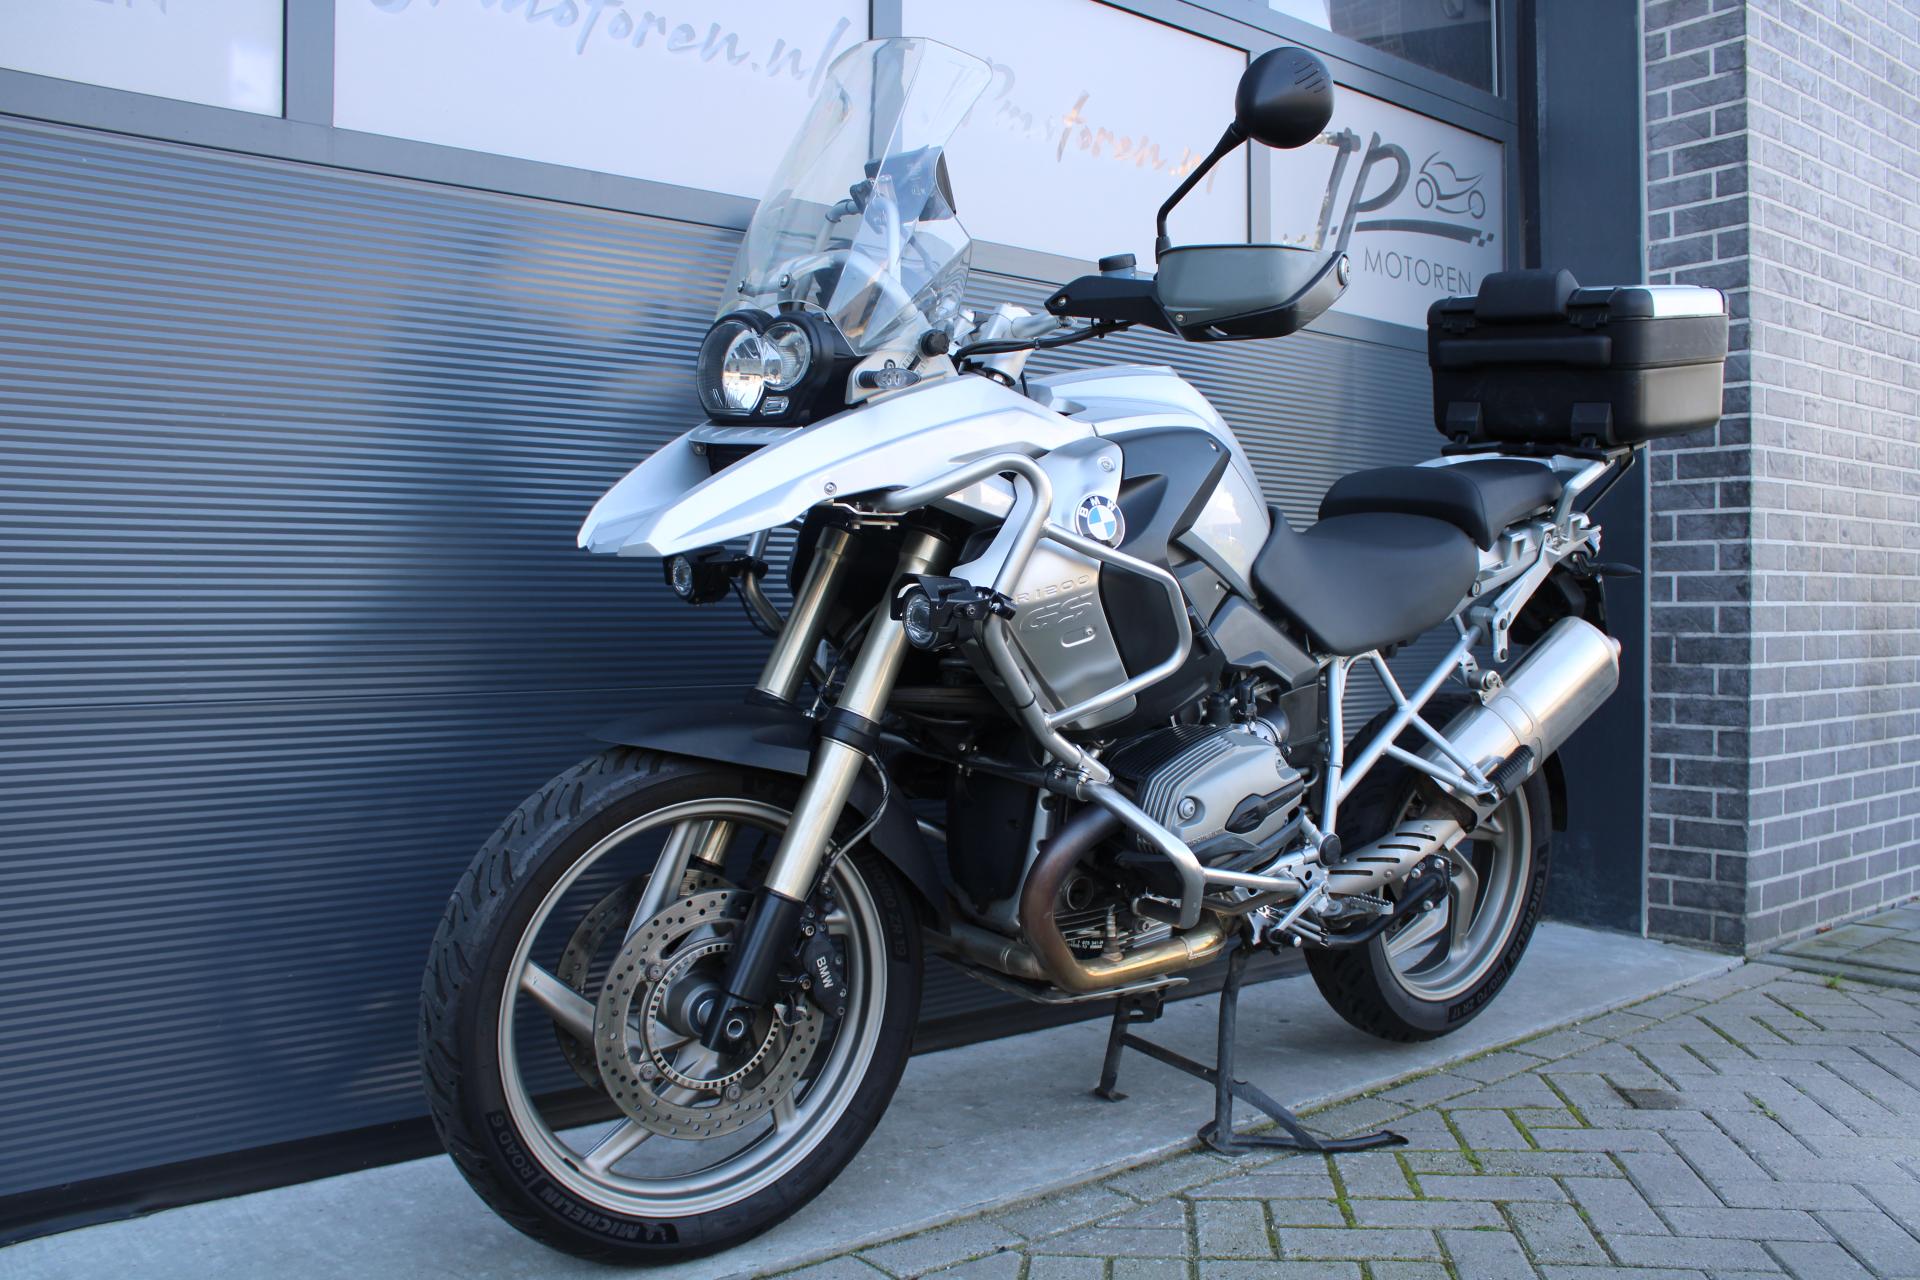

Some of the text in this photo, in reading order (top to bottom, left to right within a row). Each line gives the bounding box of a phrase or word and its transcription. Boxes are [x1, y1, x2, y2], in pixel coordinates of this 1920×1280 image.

[1364, 248, 1471, 294] MOTOREN
[1079, 496, 1116, 518] BMW
[1020, 592, 1094, 631] GS
[1506, 876, 1544, 965] MICHELIN
[816, 956, 834, 989] BMW
[499, 1132, 534, 1181] ROAD
[538, 1185, 641, 1240] MICHELIN
